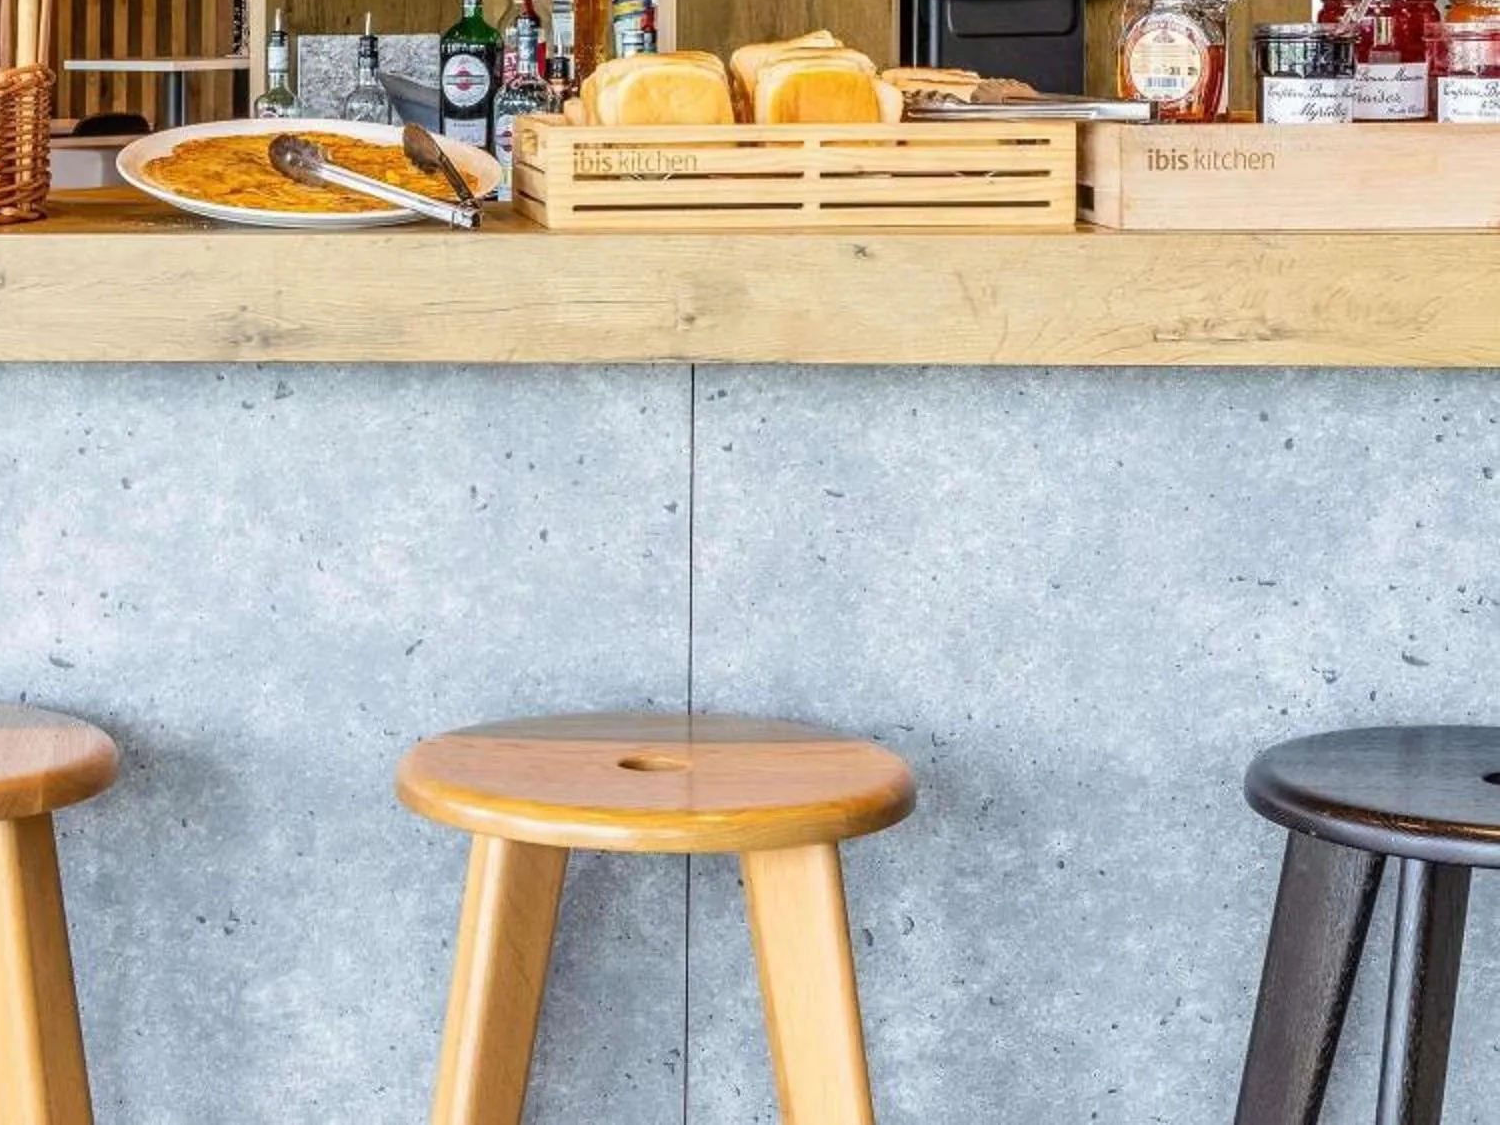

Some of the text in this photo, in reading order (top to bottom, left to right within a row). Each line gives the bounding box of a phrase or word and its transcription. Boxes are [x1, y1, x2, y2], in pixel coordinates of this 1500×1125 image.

[573, 150, 698, 172] ibis kitchen
[1147, 147, 1276, 171] ibis kitchen
